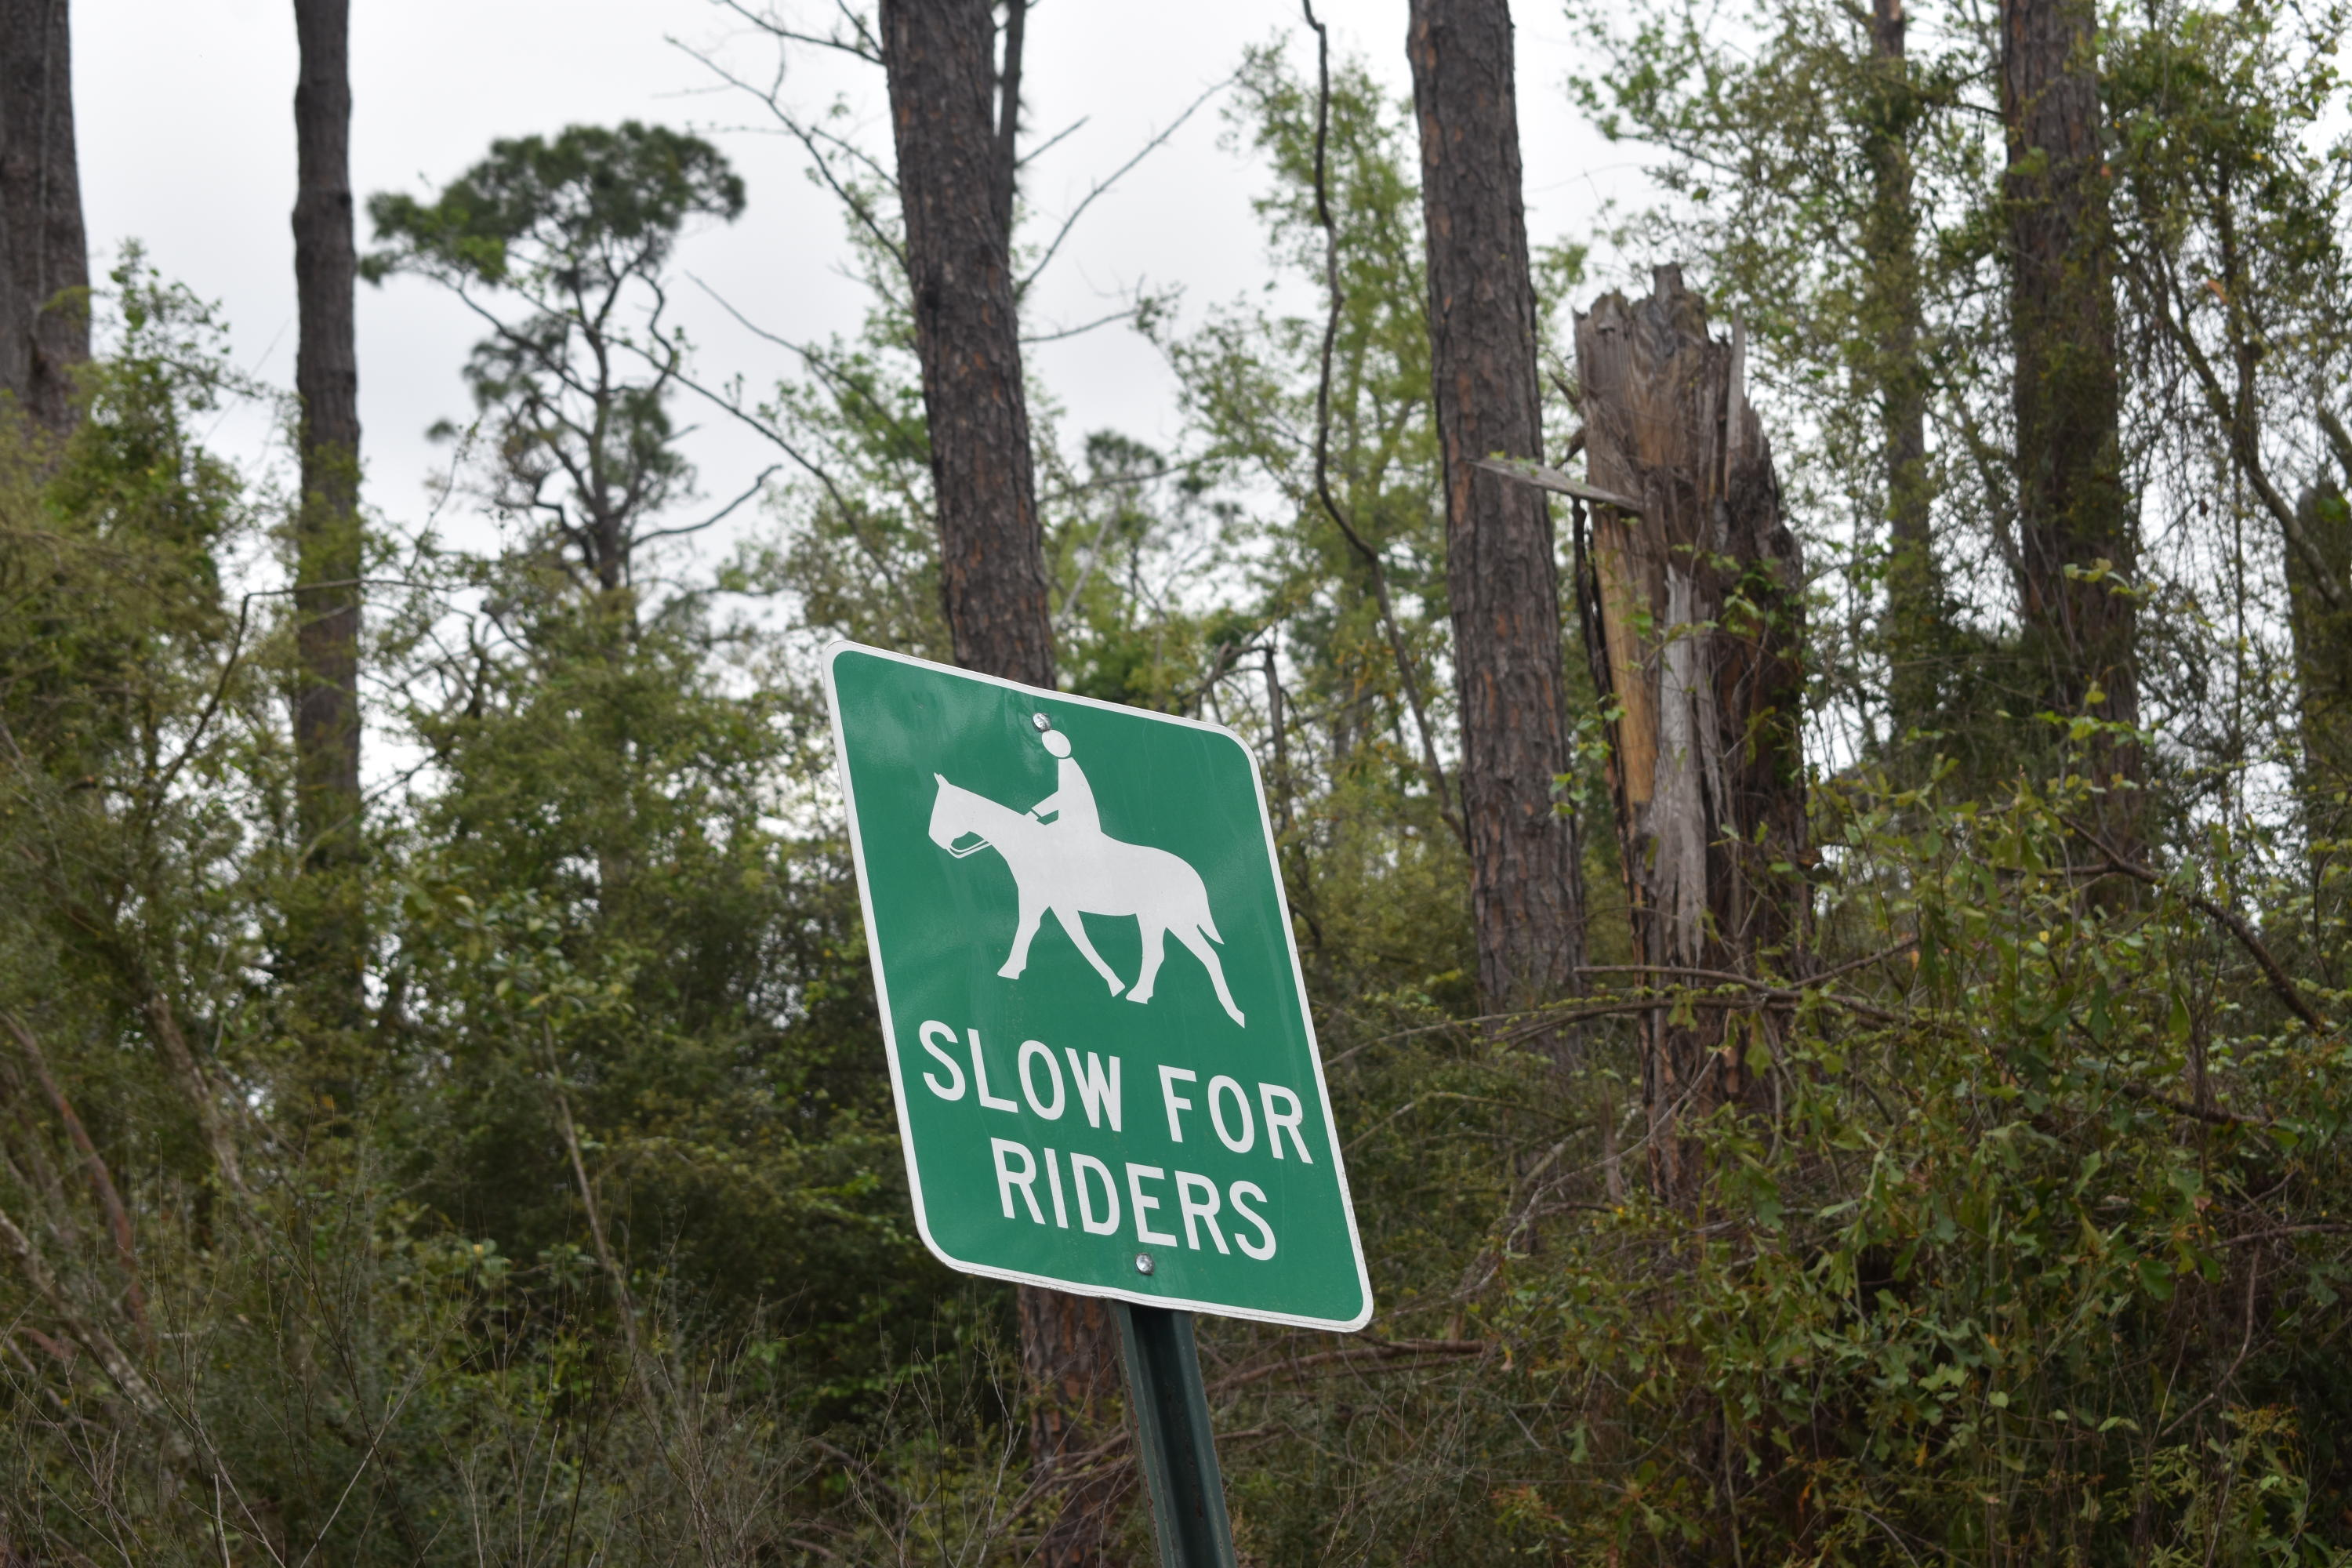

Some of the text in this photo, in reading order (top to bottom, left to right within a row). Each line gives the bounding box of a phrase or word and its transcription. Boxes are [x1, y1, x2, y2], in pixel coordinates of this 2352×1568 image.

[919, 1019, 1314, 1164] SLOW FOR
[990, 1137, 1276, 1261] RIDERS
